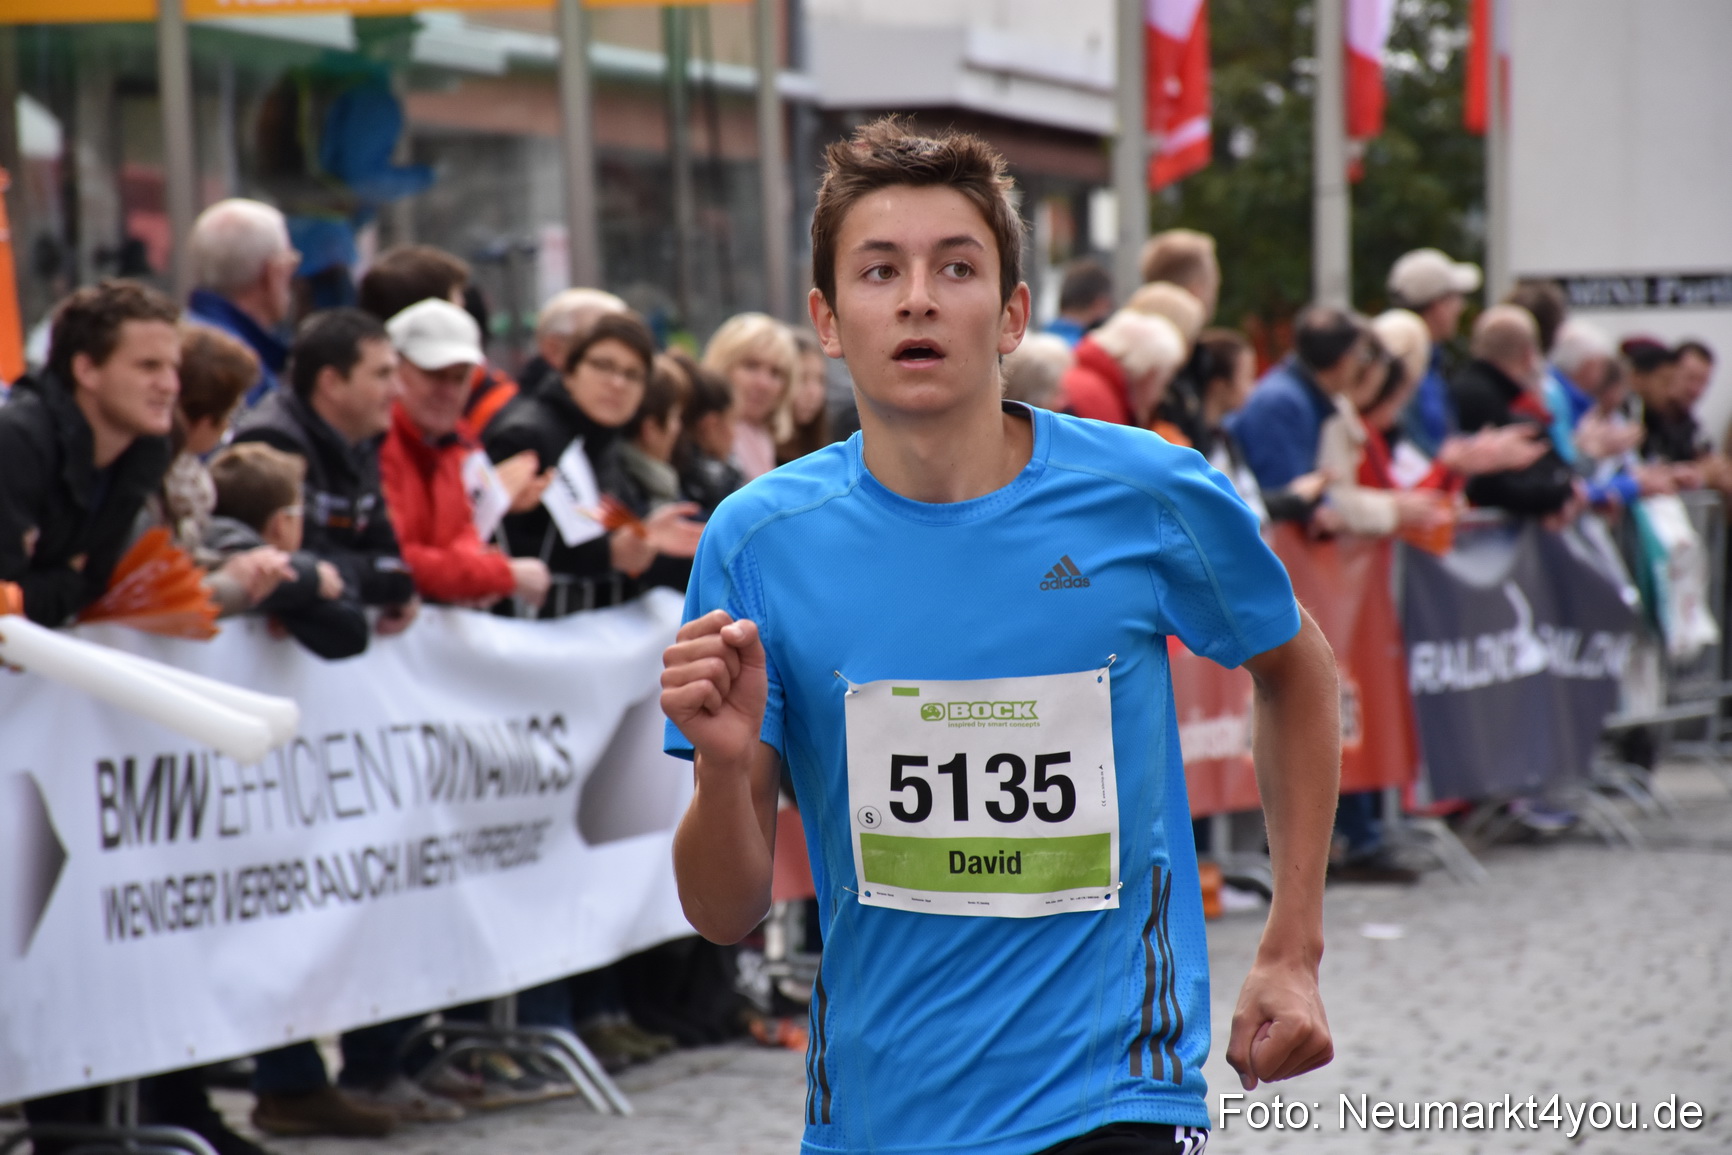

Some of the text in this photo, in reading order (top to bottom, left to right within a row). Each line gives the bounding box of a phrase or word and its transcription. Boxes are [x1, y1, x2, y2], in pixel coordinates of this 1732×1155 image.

[1040, 576, 1090, 591] adidas
[947, 700, 1039, 720] BOCK
[977, 720, 986, 728] by
[1009, 720, 1041, 728] concepts
[889, 751, 1077, 823] 5135
[864, 812, 875, 824] S
[949, 850, 1023, 875] David
[103, 870, 216, 943] WENIGER
